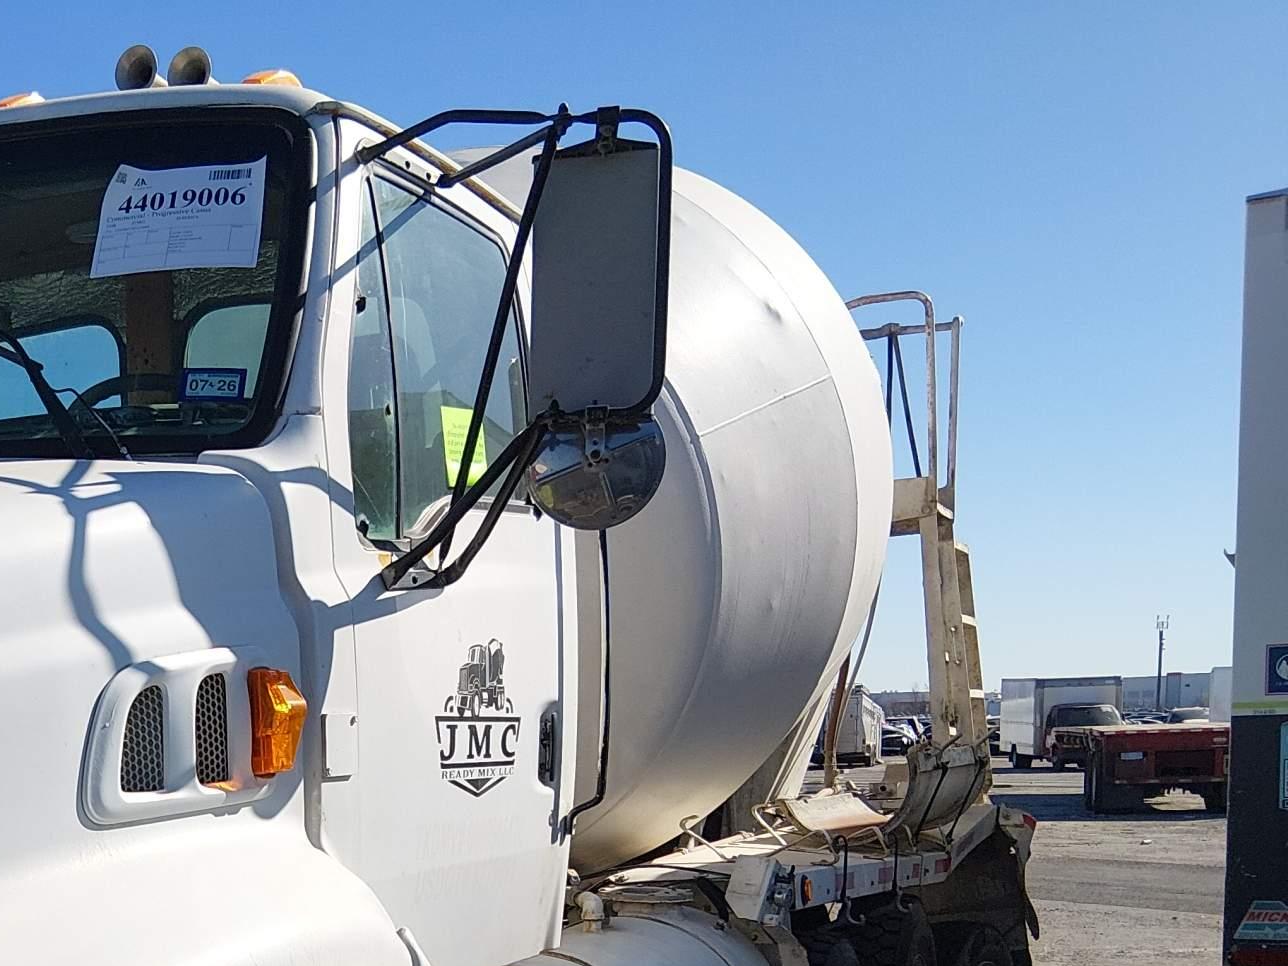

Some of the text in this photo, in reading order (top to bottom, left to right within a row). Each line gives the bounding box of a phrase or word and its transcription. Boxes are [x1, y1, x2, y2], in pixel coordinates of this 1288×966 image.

[118, 186, 248, 214] 44019006
[189, 379, 237, 391] 07 26
[441, 766, 515, 780] READY MIX LLC
